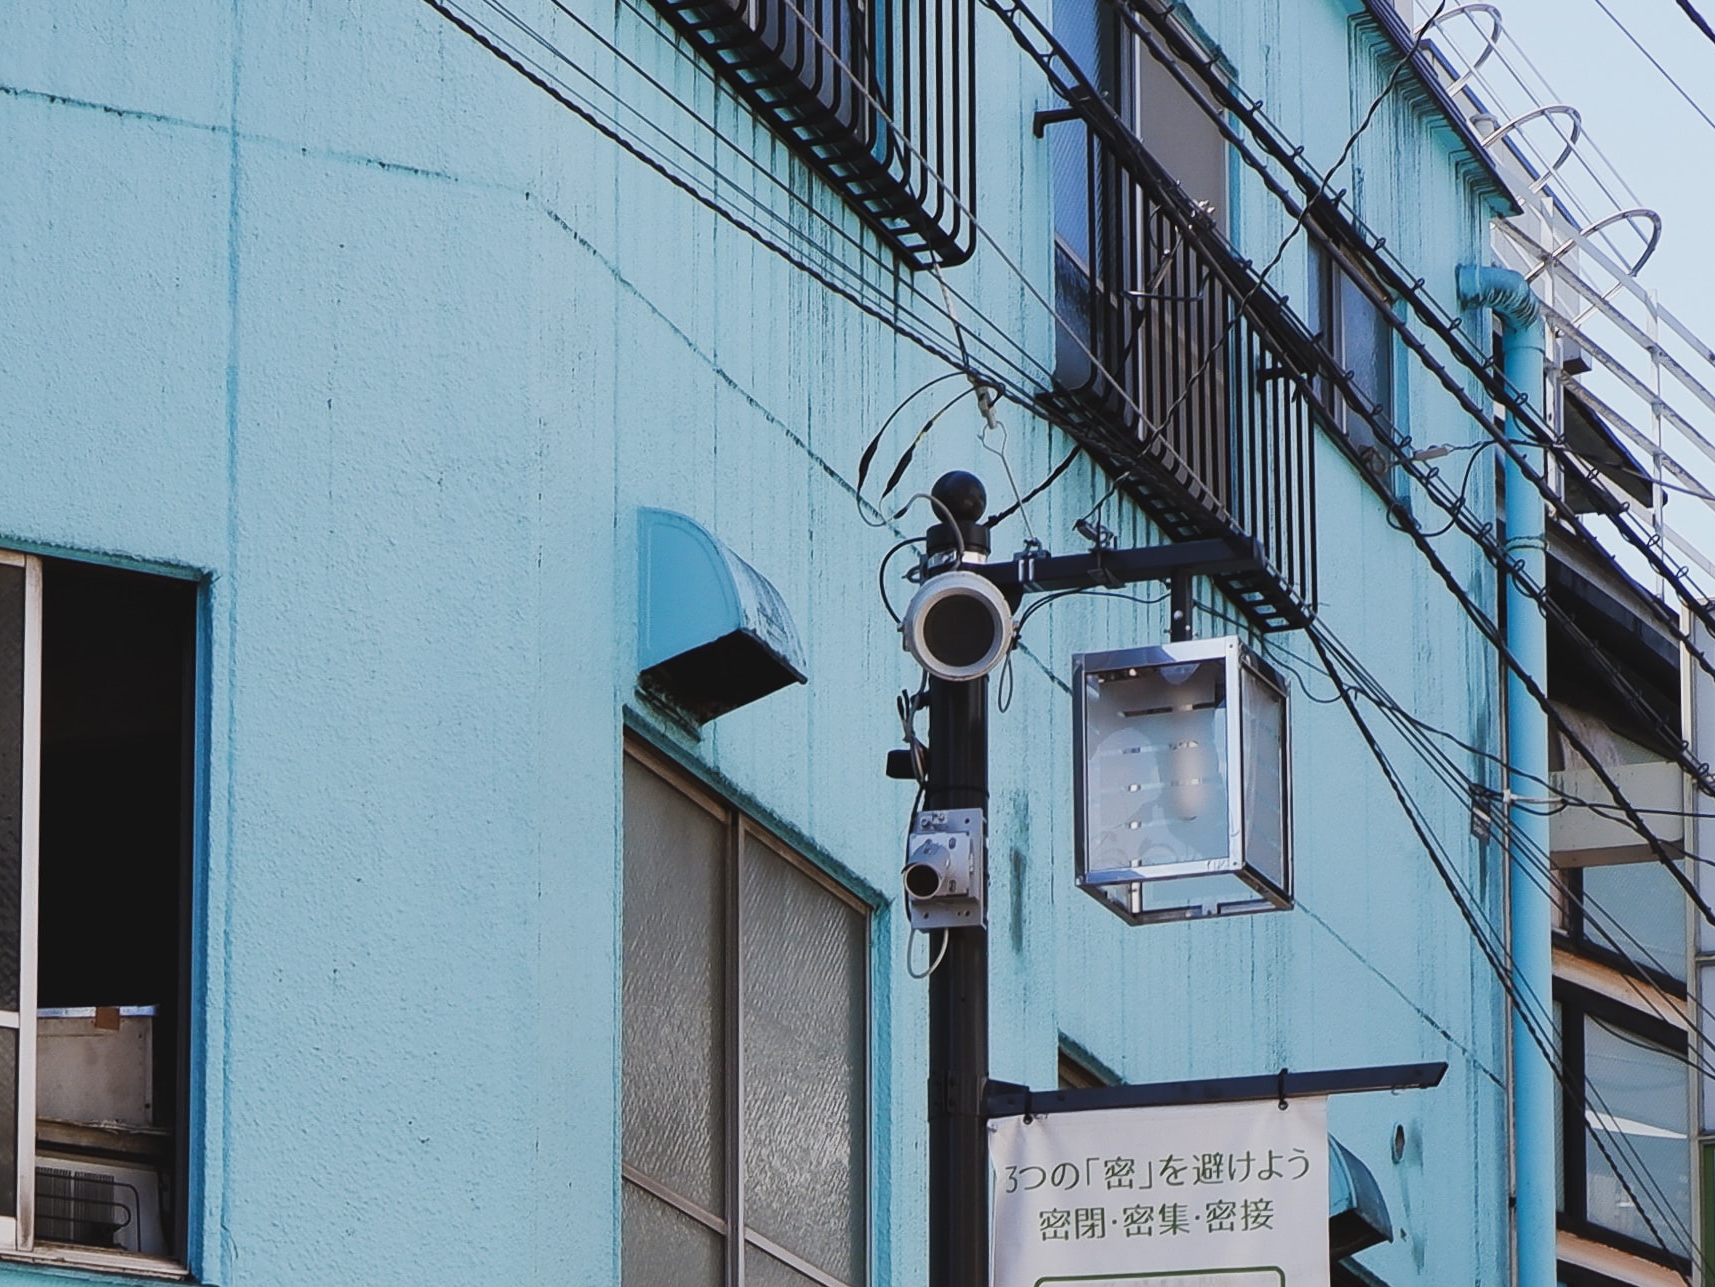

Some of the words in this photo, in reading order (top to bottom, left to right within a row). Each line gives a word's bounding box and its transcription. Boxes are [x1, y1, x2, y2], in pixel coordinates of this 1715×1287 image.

[1005, 1148, 1311, 1193] 3つの「密」を避けよう
[1039, 1198, 1274, 1241] 密閉・密集・密接
